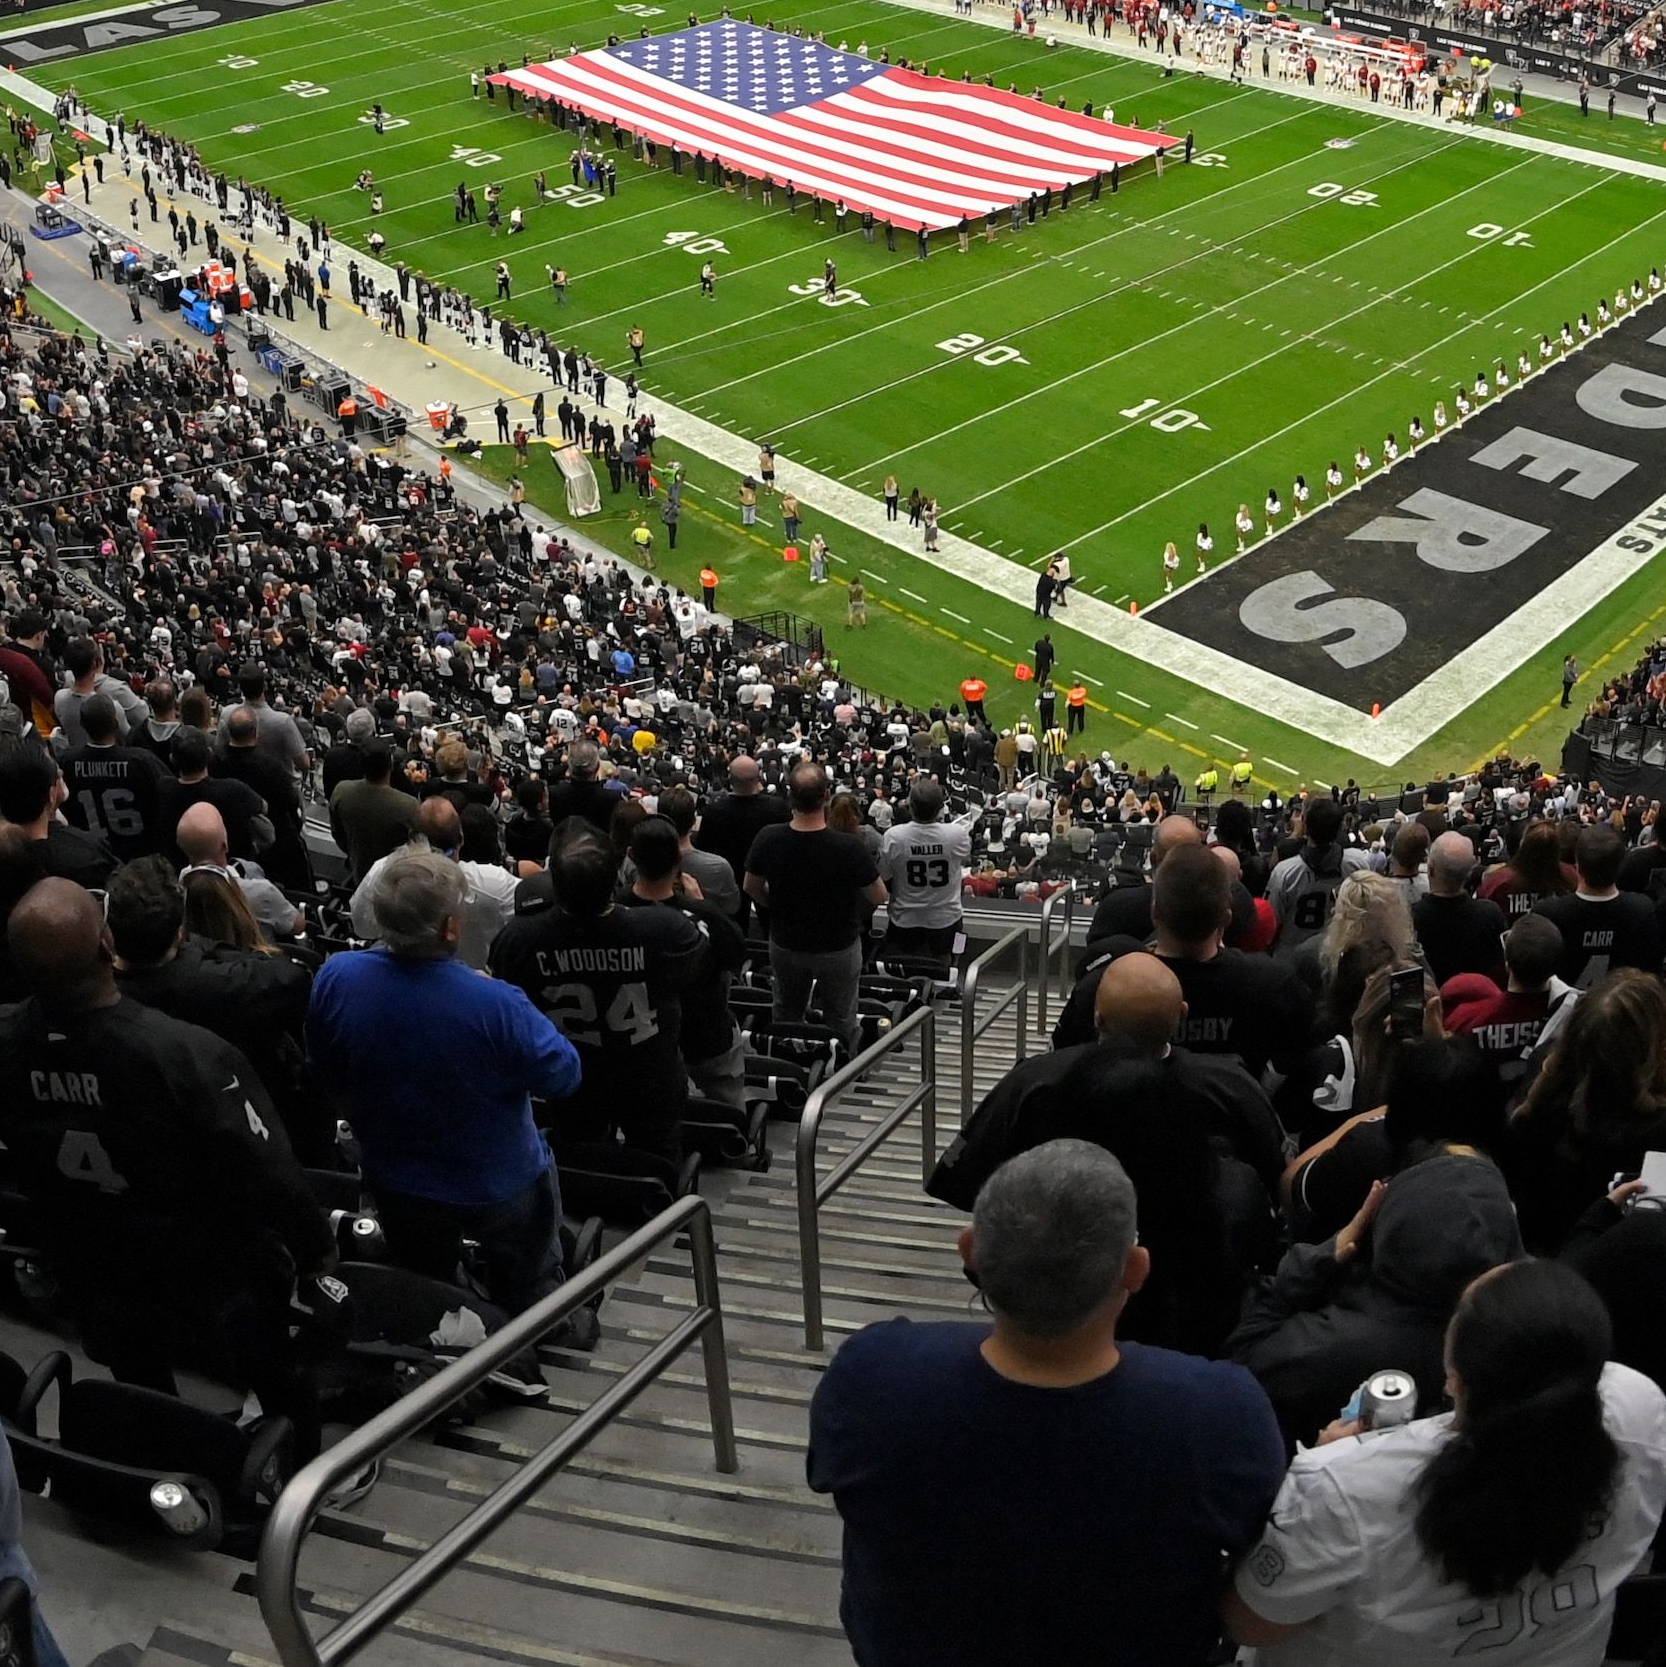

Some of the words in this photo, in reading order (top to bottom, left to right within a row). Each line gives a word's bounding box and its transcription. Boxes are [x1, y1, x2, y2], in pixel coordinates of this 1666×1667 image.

[0, 4, 221, 62] LAS
[280, 81, 330, 98] 20
[449, 148, 502, 167] 40
[545, 185, 606, 207] 50
[1307, 183, 1378, 206] 20
[662, 231, 726, 255] 40
[1466, 223, 1531, 247] 10
[788, 277, 862, 307] 30
[935, 334, 1021, 366] 20
[1119, 397, 1195, 434] 10
[75, 761, 129, 778] PLUNKETT
[78, 789, 139, 838] 16
[910, 844, 943, 856] WALLER
[906, 860, 949, 887] 83
[1582, 930, 1614, 947] CARR
[536, 947, 645, 976] C.WOODSON
[542, 982, 659, 1046] 24
[31, 1071, 103, 1107] CARR
[244, 1099, 269, 1141] 4
[59, 1130, 130, 1194] 4
